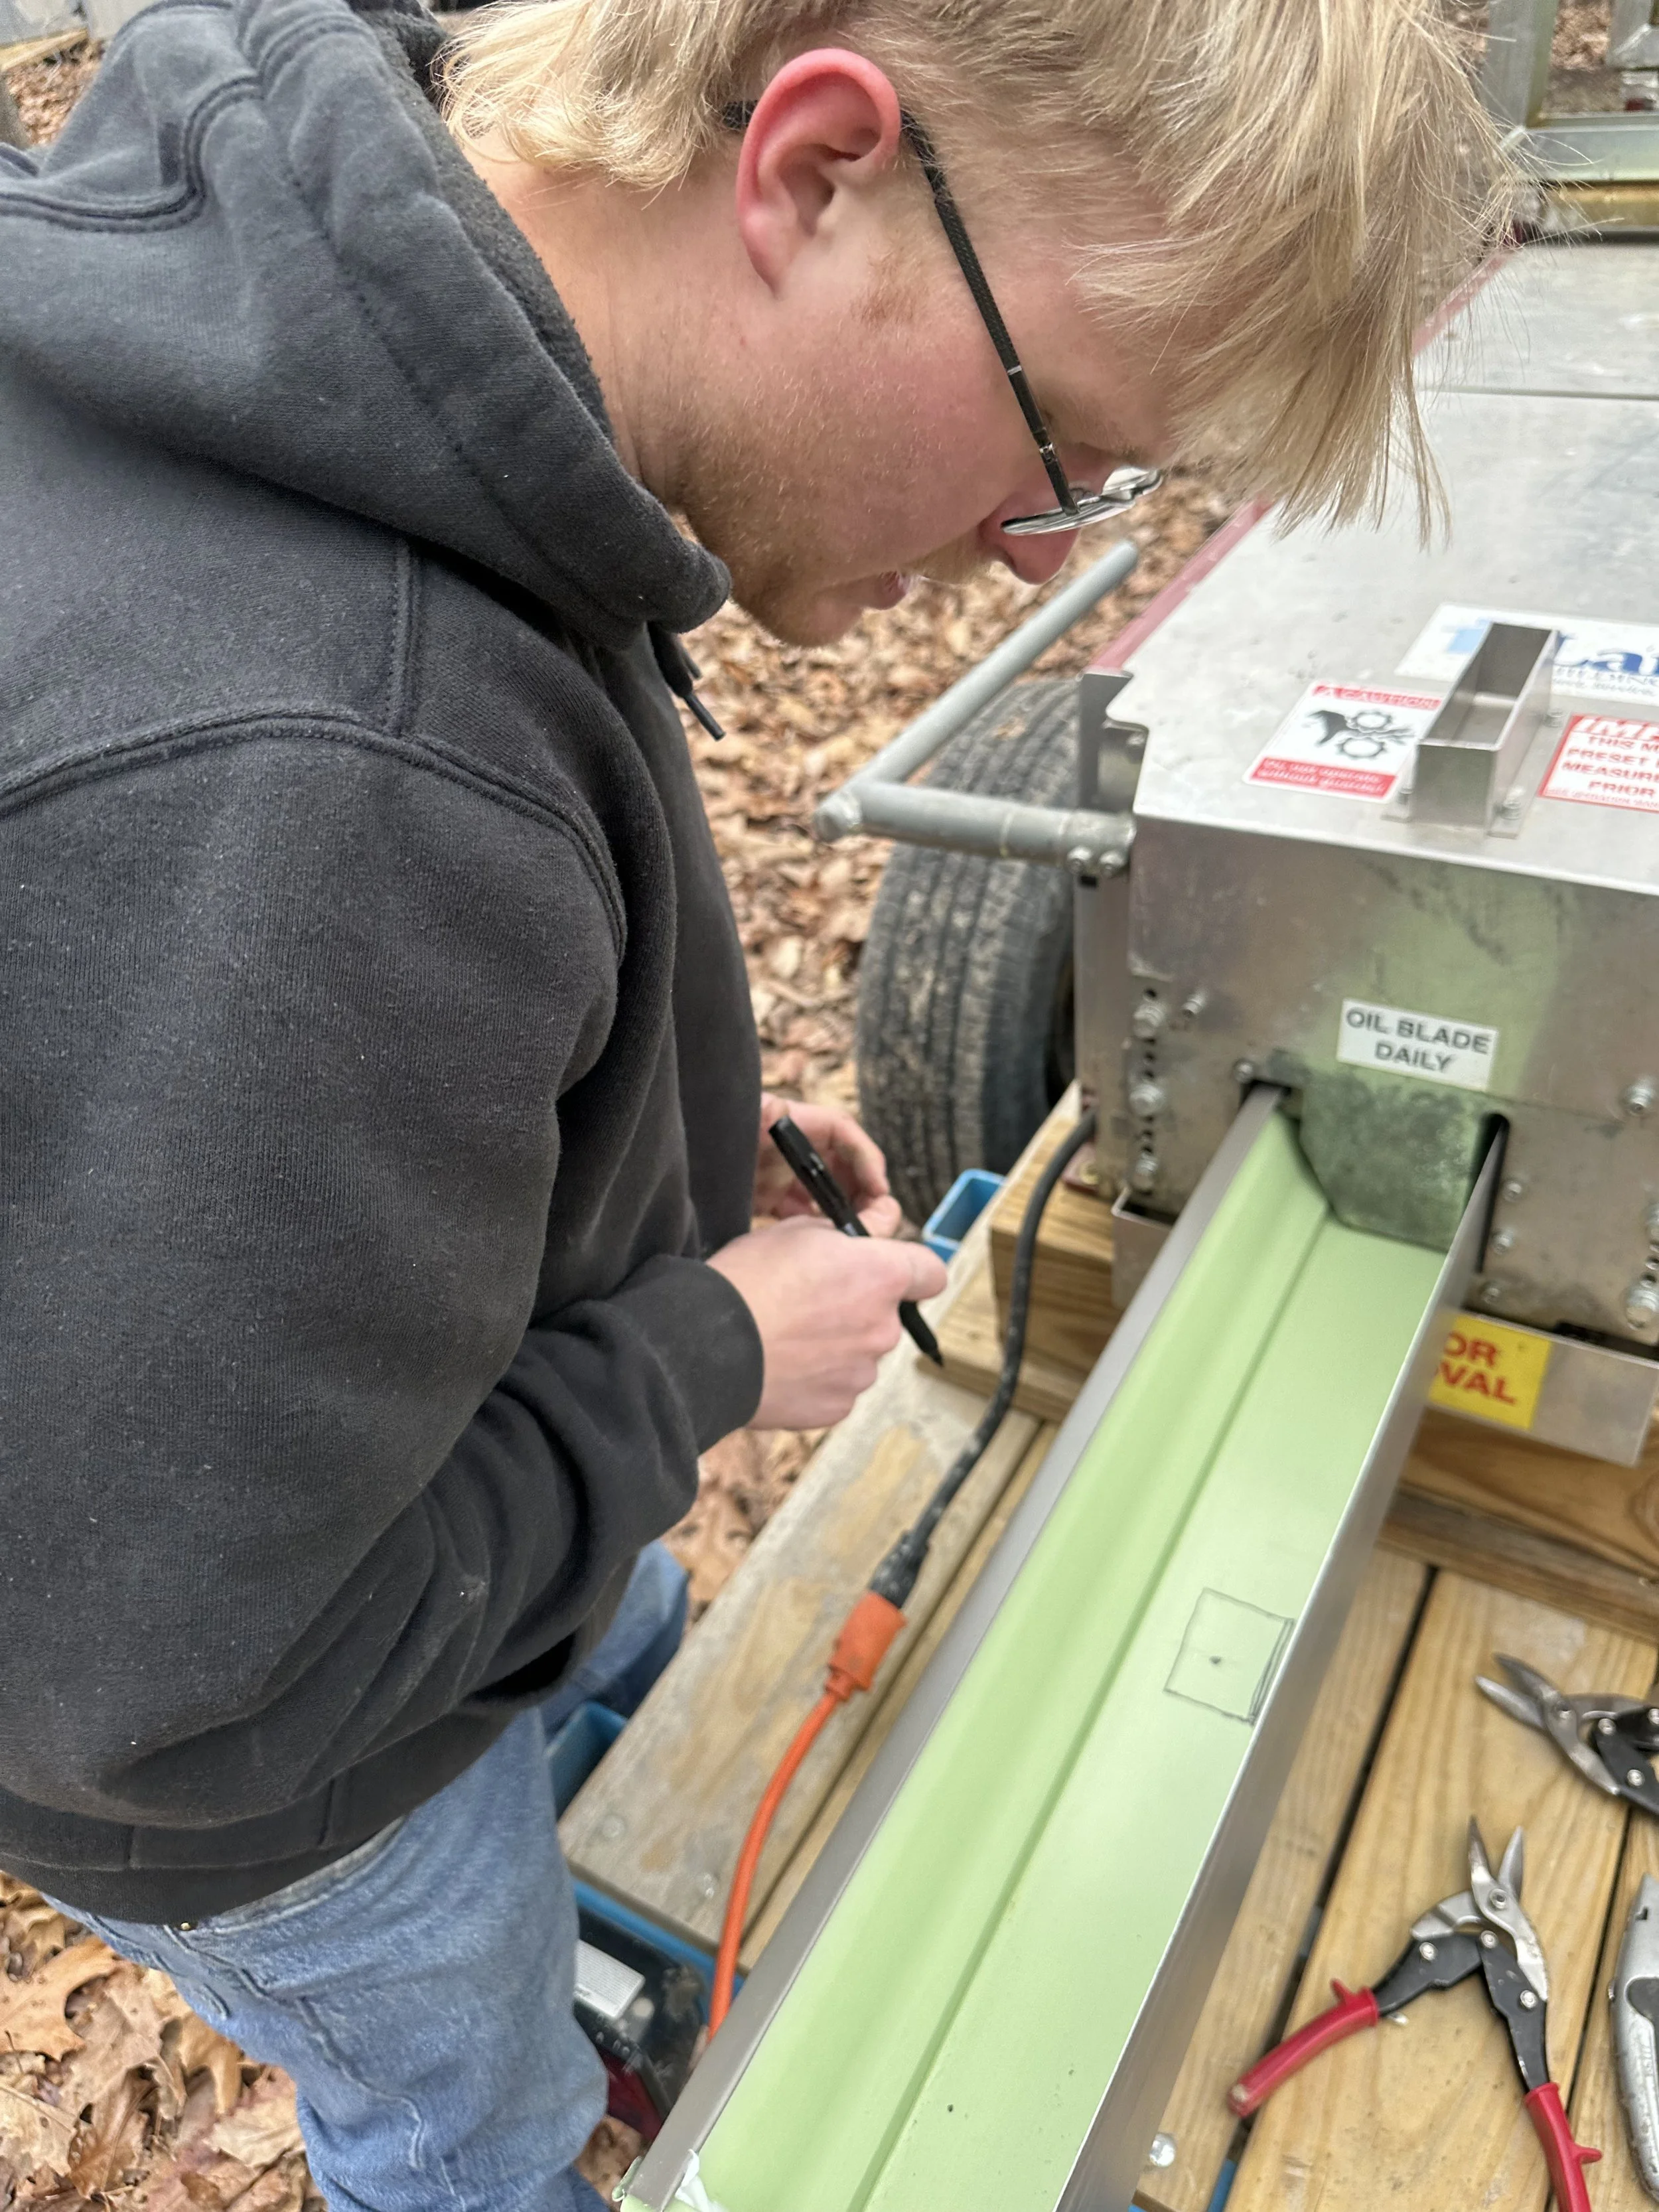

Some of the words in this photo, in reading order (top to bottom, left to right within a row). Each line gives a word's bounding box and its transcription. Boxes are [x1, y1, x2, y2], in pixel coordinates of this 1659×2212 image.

[1588, 735, 1635, 749] THIS
[1567, 748, 1650, 766] PRESET
[1589, 780, 1656, 798] PRIOR
[1346, 1007, 1388, 1033] OIL
[1396, 1017, 1492, 1054] BLADE
[1374, 1041, 1453, 1072] DAILY
[1435, 1361, 1518, 1406] VAL
